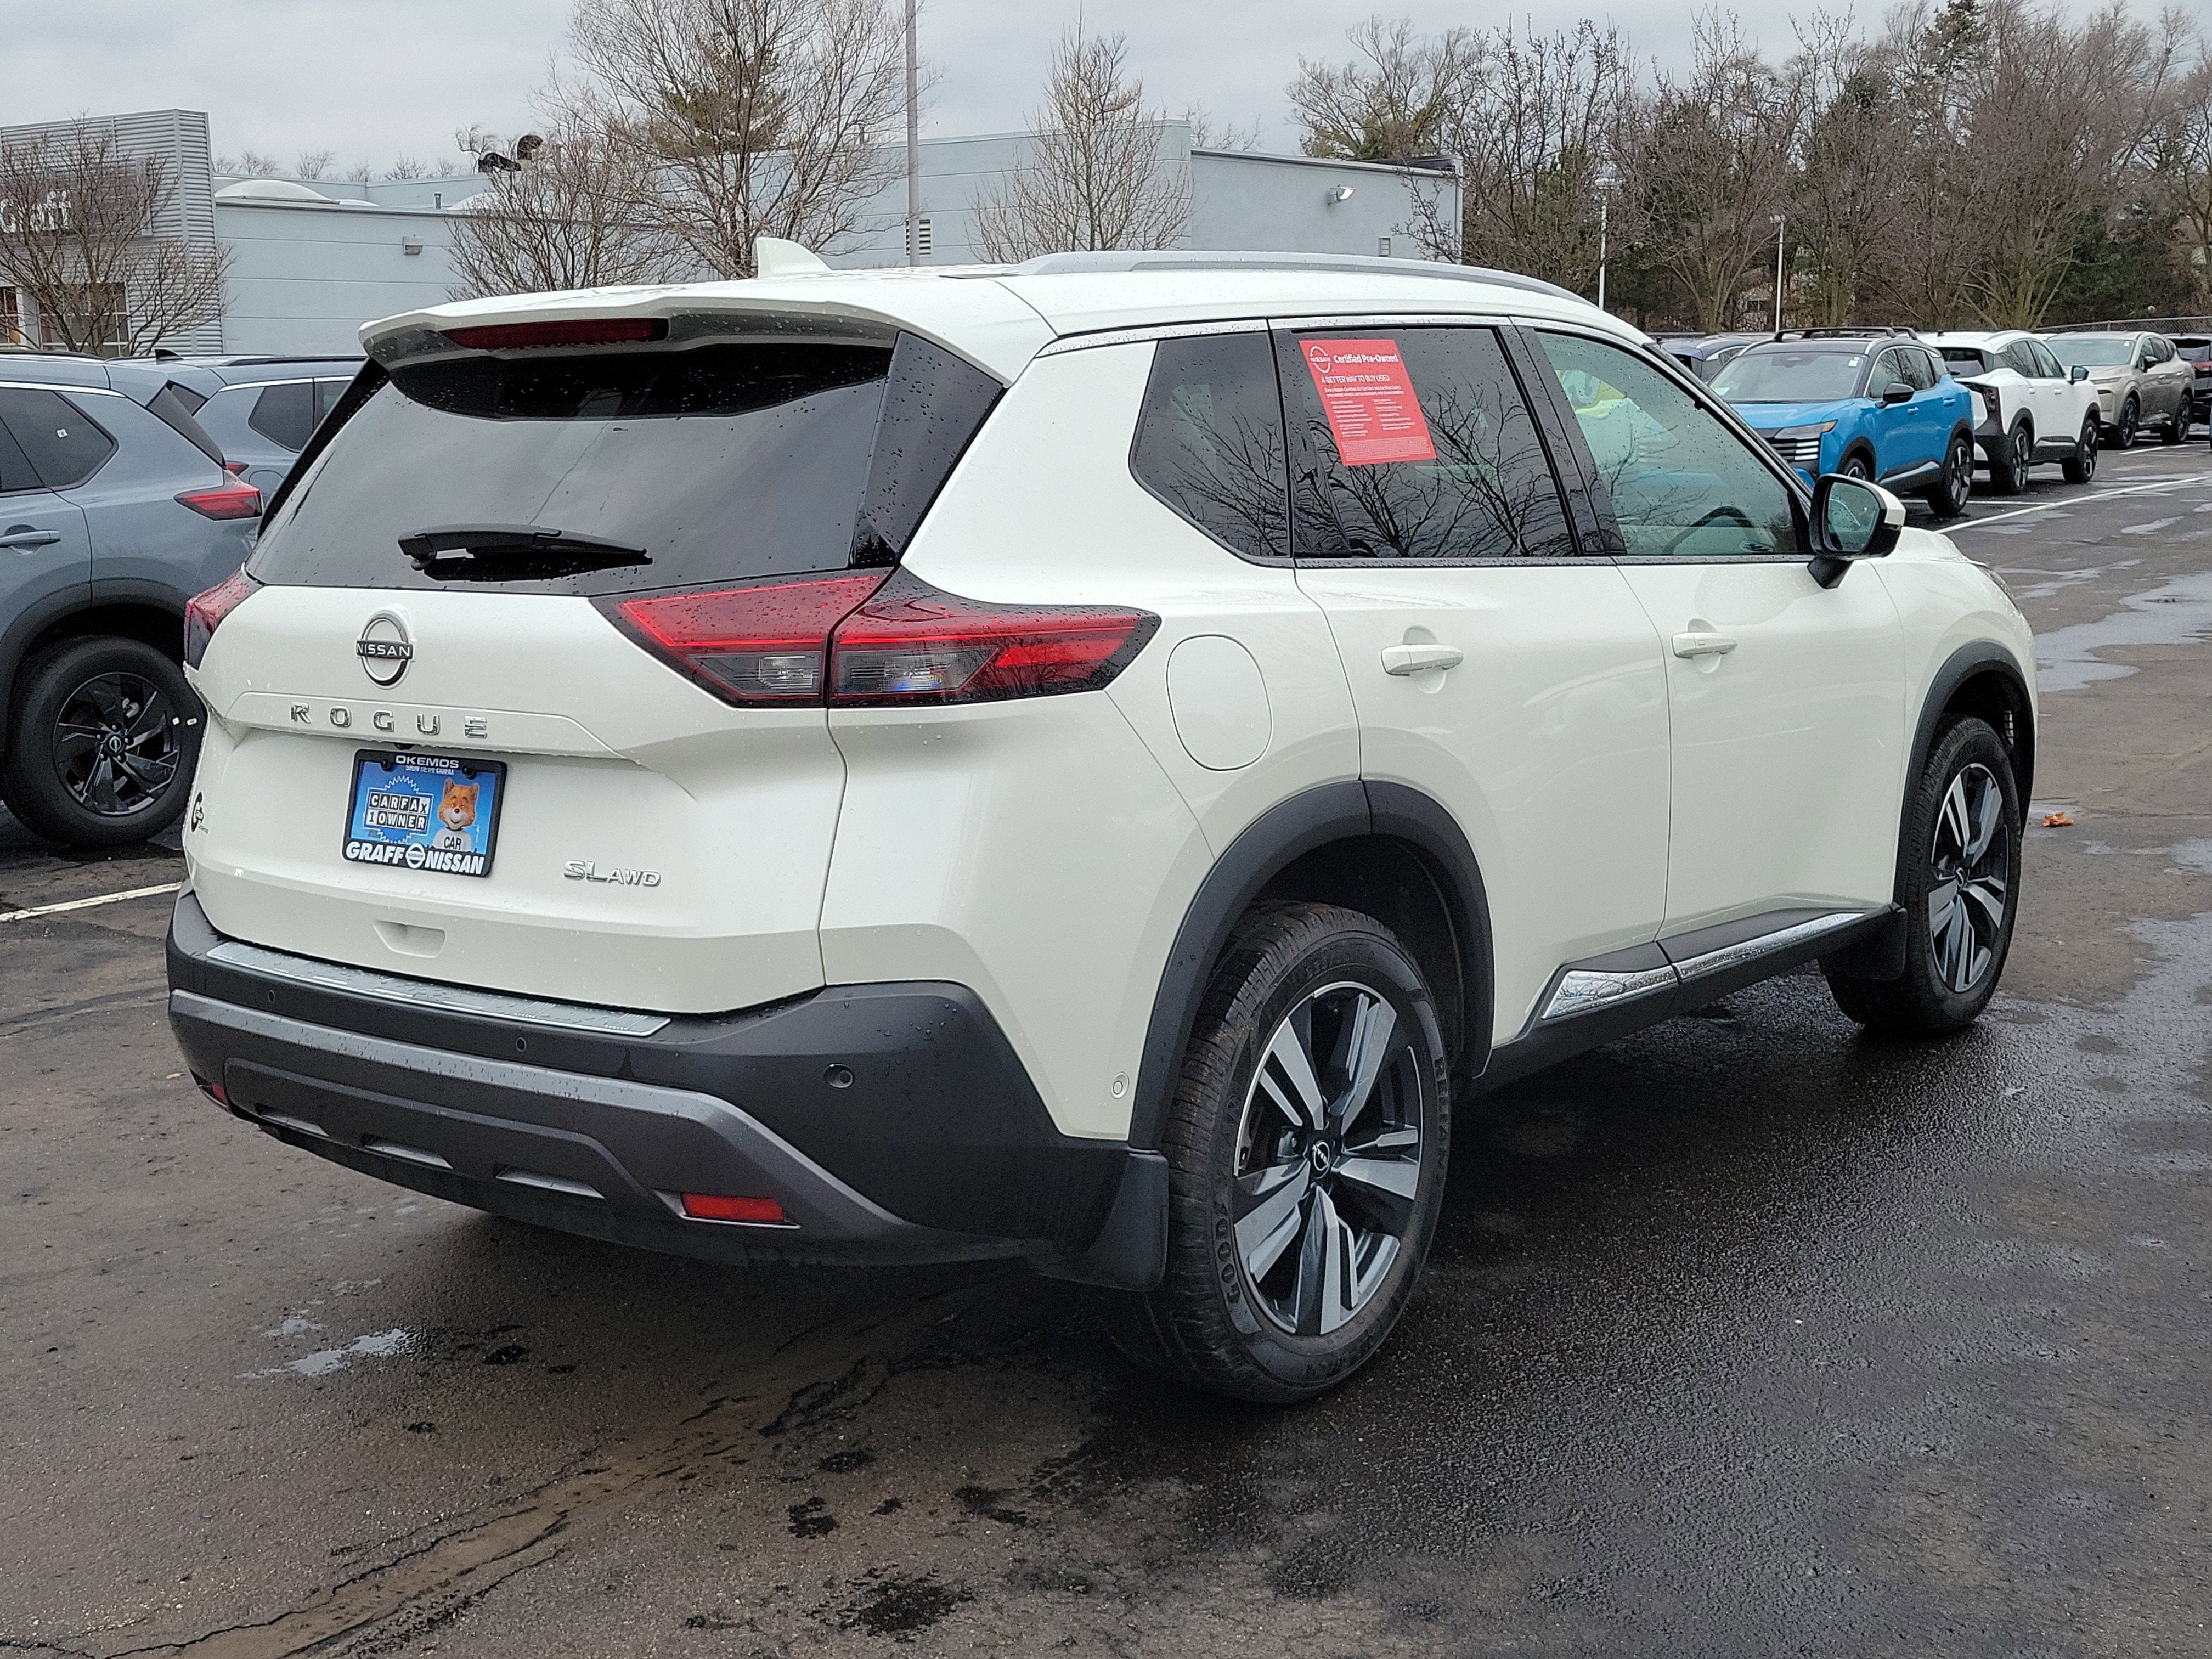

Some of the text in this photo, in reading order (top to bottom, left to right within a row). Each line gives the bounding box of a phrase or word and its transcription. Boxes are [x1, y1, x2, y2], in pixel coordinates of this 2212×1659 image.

[1333, 353, 1398, 364] Certified Pre-Owned
[357, 643, 410, 657] NISSAN
[290, 702, 488, 738] ROGUE
[396, 755, 459, 769] OKEMOS
[370, 794, 429, 814] CARFAX
[443, 836, 461, 850] CAR
[346, 841, 485, 875] GRAFF NISSAN
[563, 860, 661, 887] SL AWD
